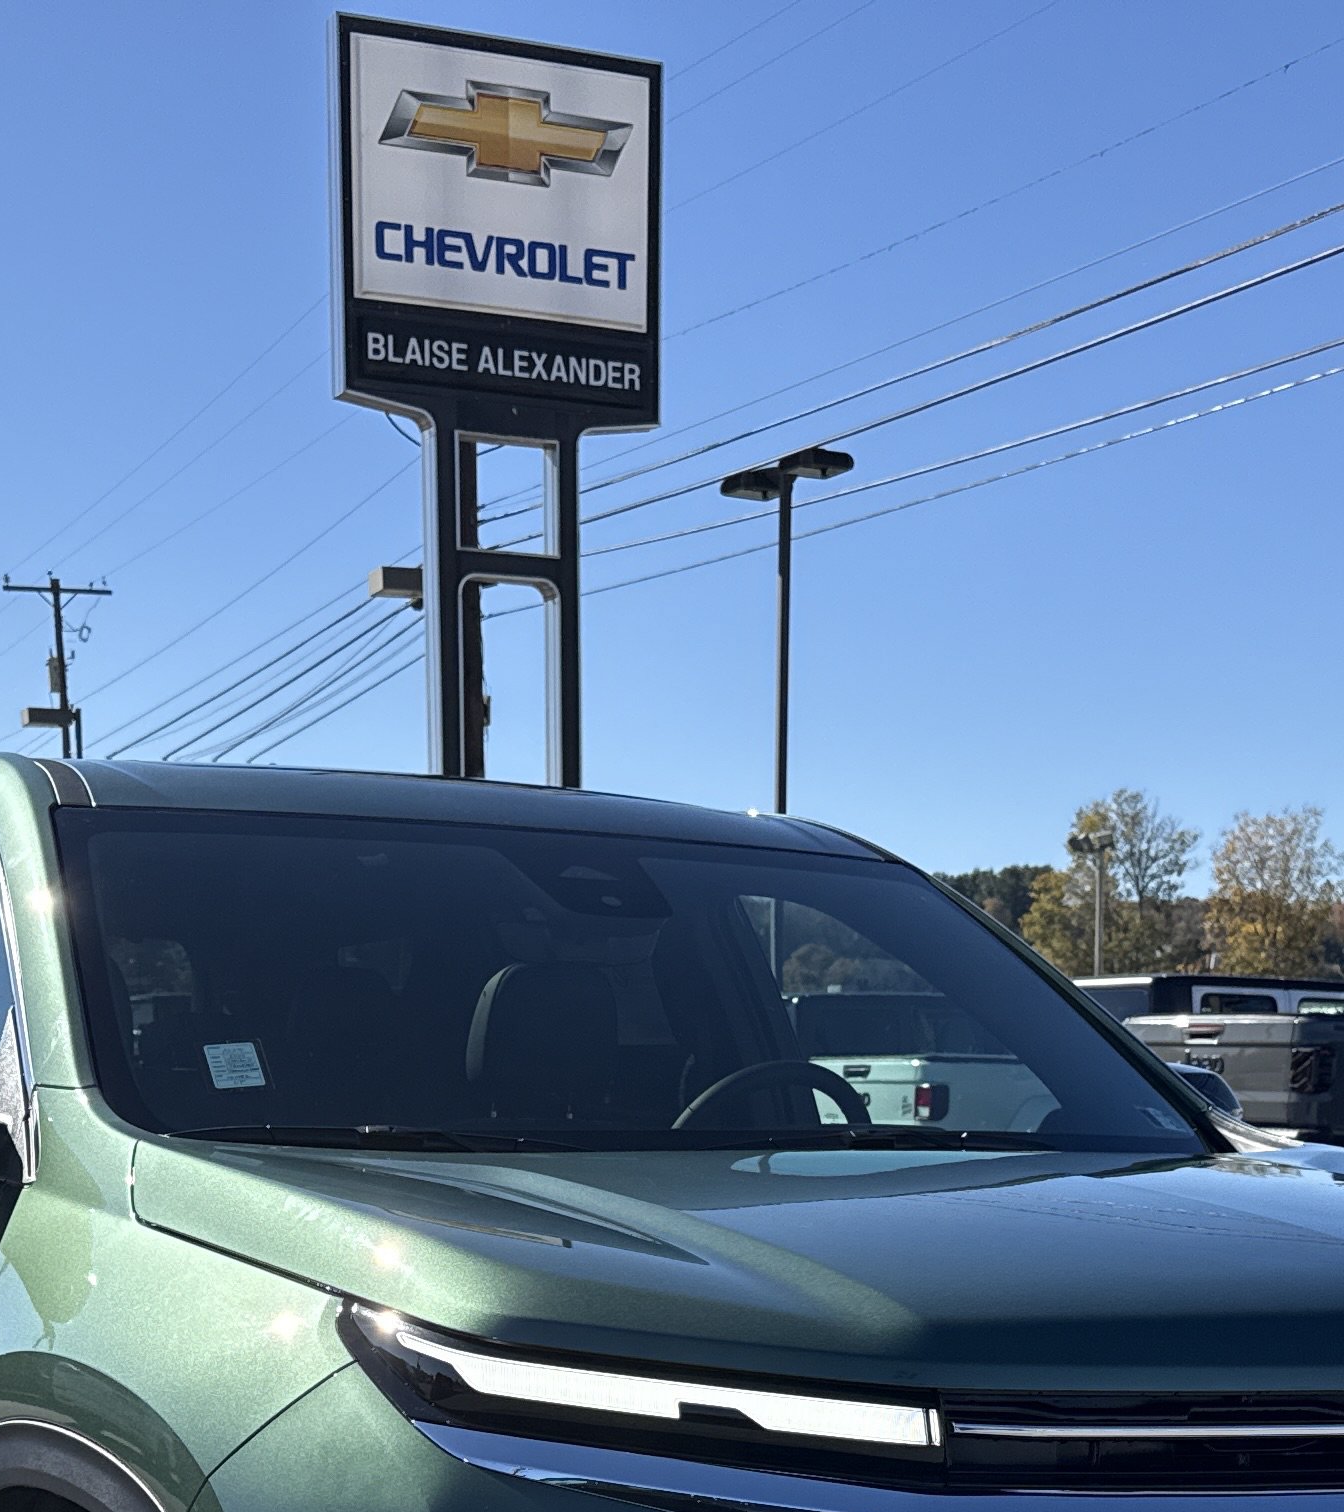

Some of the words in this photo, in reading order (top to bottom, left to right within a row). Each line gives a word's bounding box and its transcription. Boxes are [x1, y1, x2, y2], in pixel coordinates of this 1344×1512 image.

[375, 221, 635, 290] CHEVROLET
[367, 332, 468, 371] BLAISE
[477, 346, 641, 391] ALEXANDER
